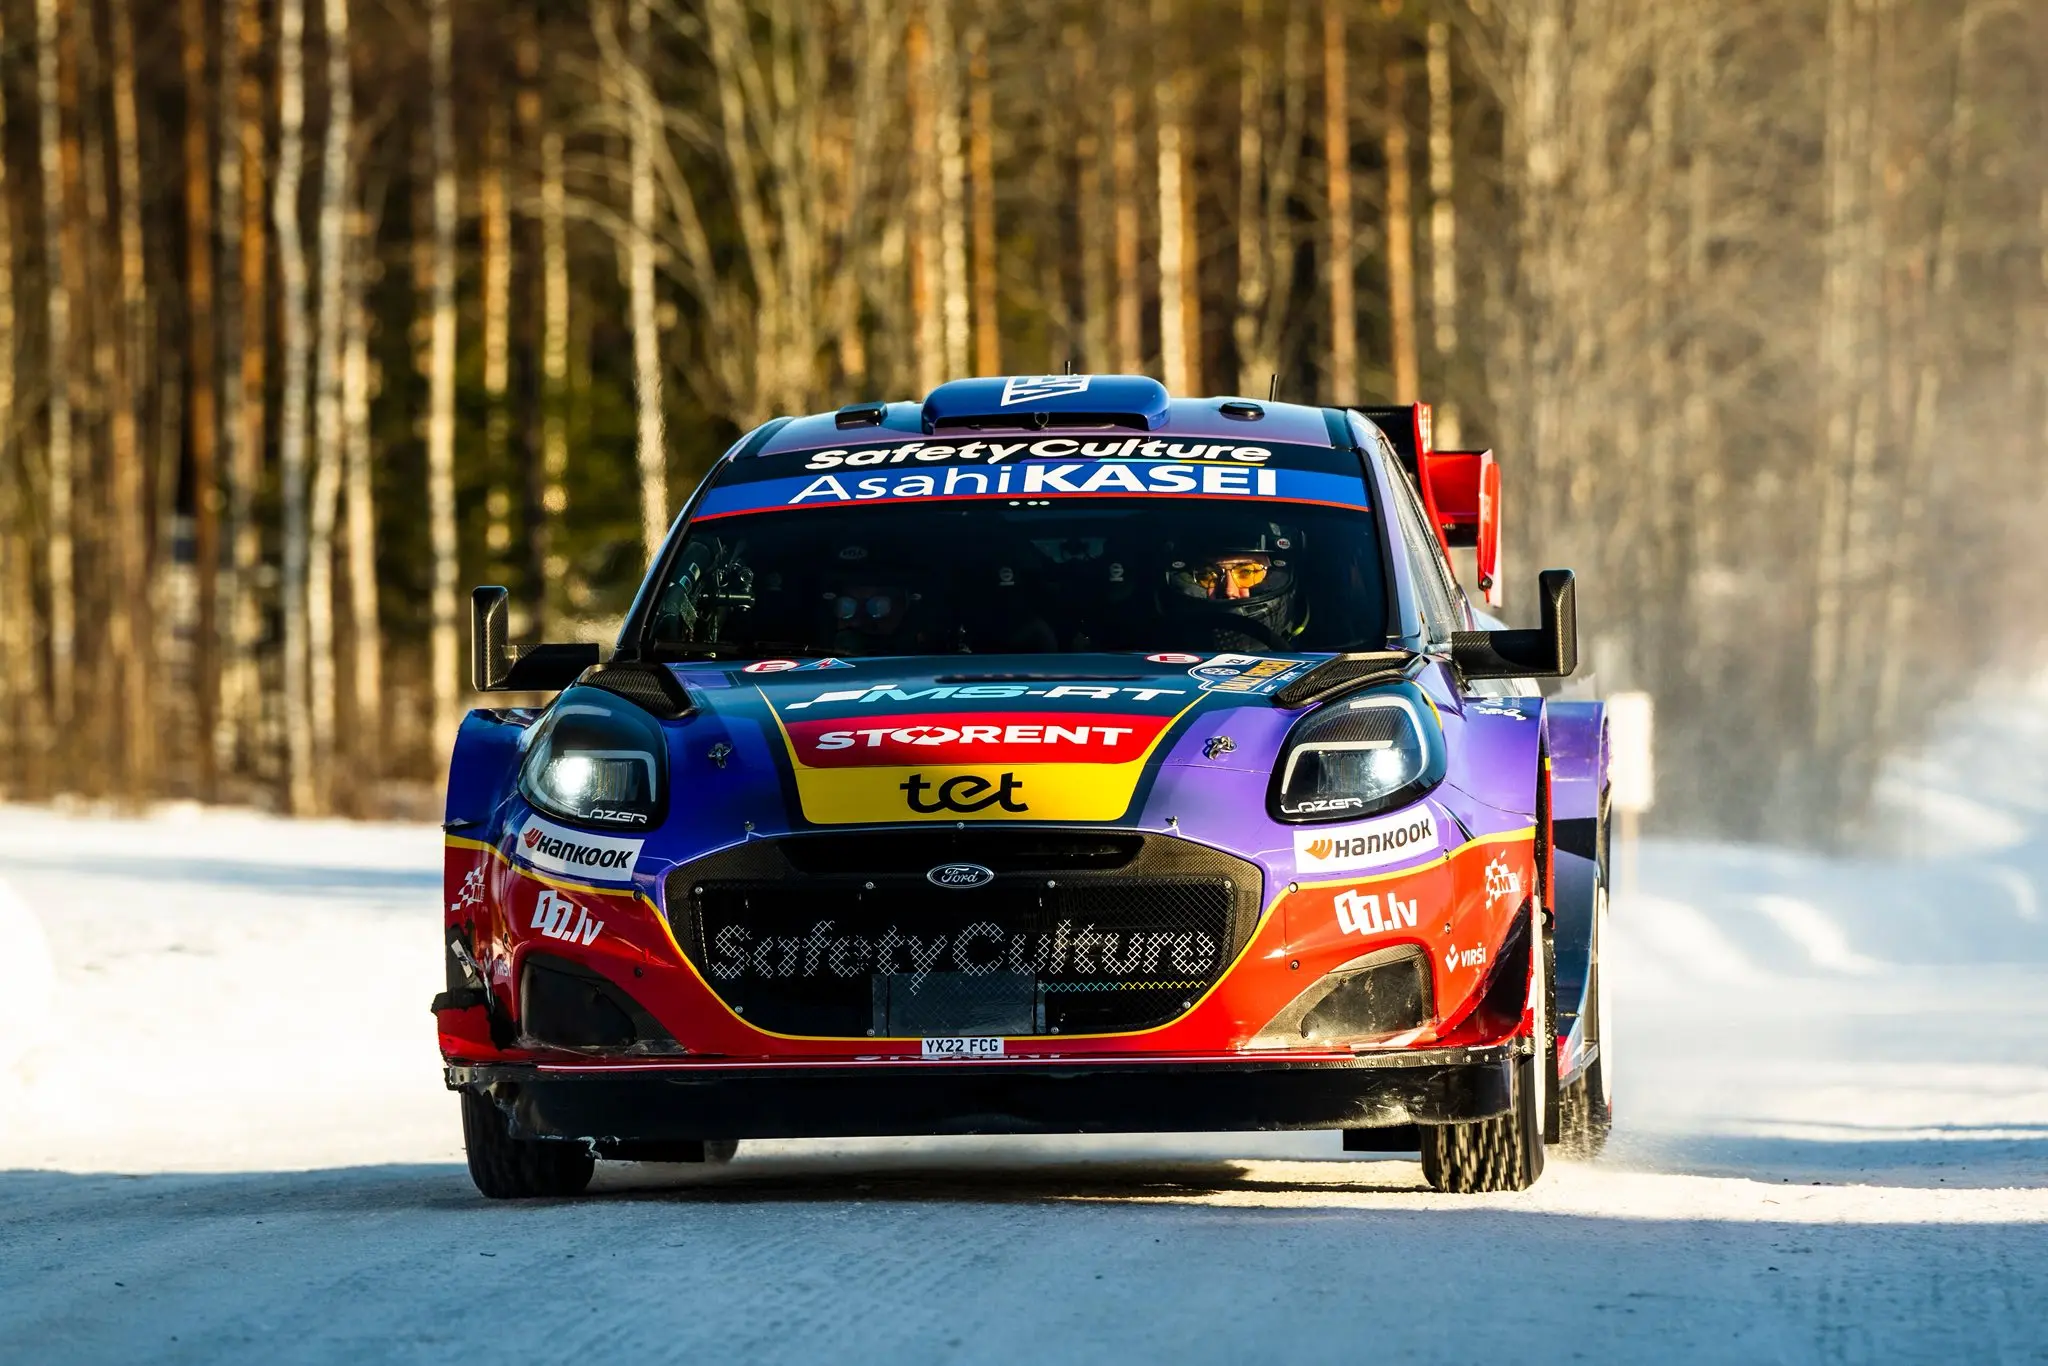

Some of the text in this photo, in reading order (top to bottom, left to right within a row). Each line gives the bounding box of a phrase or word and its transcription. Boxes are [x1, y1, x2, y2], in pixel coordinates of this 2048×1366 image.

[805, 439, 1272, 470] SafetyCulture
[815, 725, 1133, 750] STORENT
[900, 772, 1030, 814] tet
[577, 808, 648, 824] LAZER
[1281, 797, 1364, 815] LAZER
[940, 867, 978, 883] Ford
[711, 920, 1217, 996] SafetyCulture
[1461, 942, 1487, 967] VIRŠI
[925, 1038, 998, 1053] YX22 FCG
